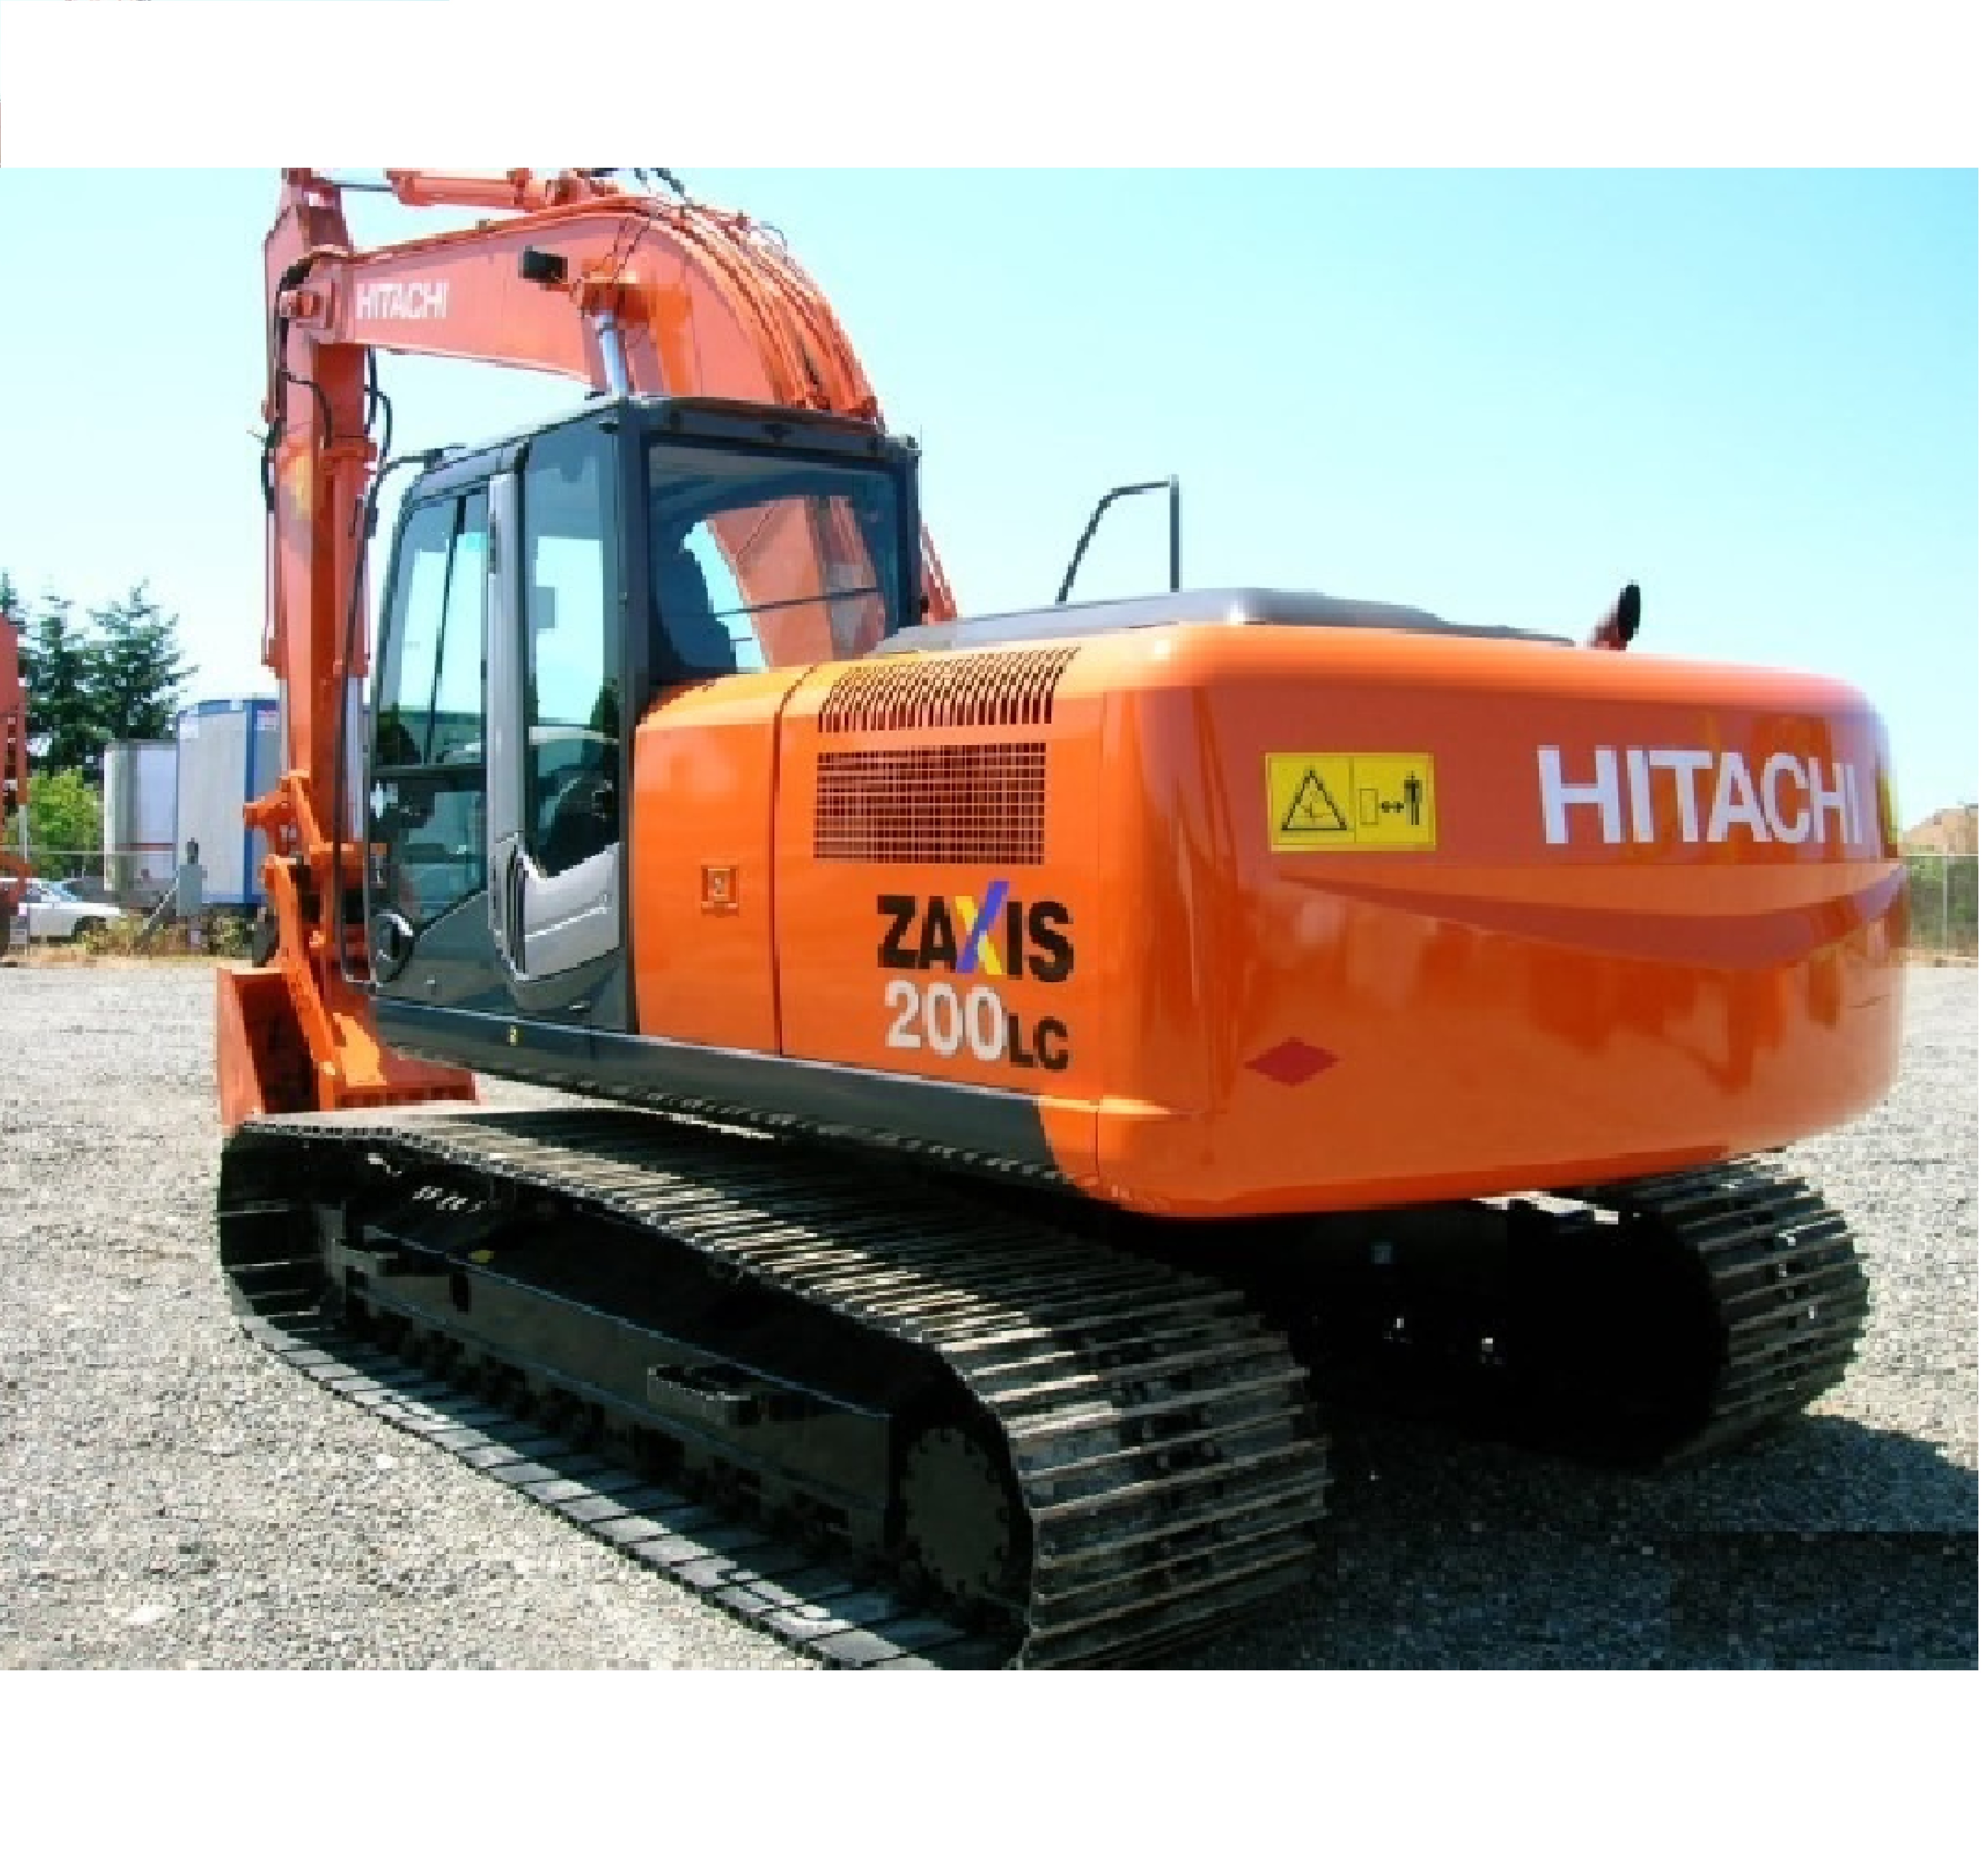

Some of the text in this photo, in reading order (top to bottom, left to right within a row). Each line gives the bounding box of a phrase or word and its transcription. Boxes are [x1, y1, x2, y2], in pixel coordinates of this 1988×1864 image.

[355, 282, 448, 318] HITACHI
[1537, 745, 1862, 844] HITACHI
[877, 881, 1074, 983] ZAXIS
